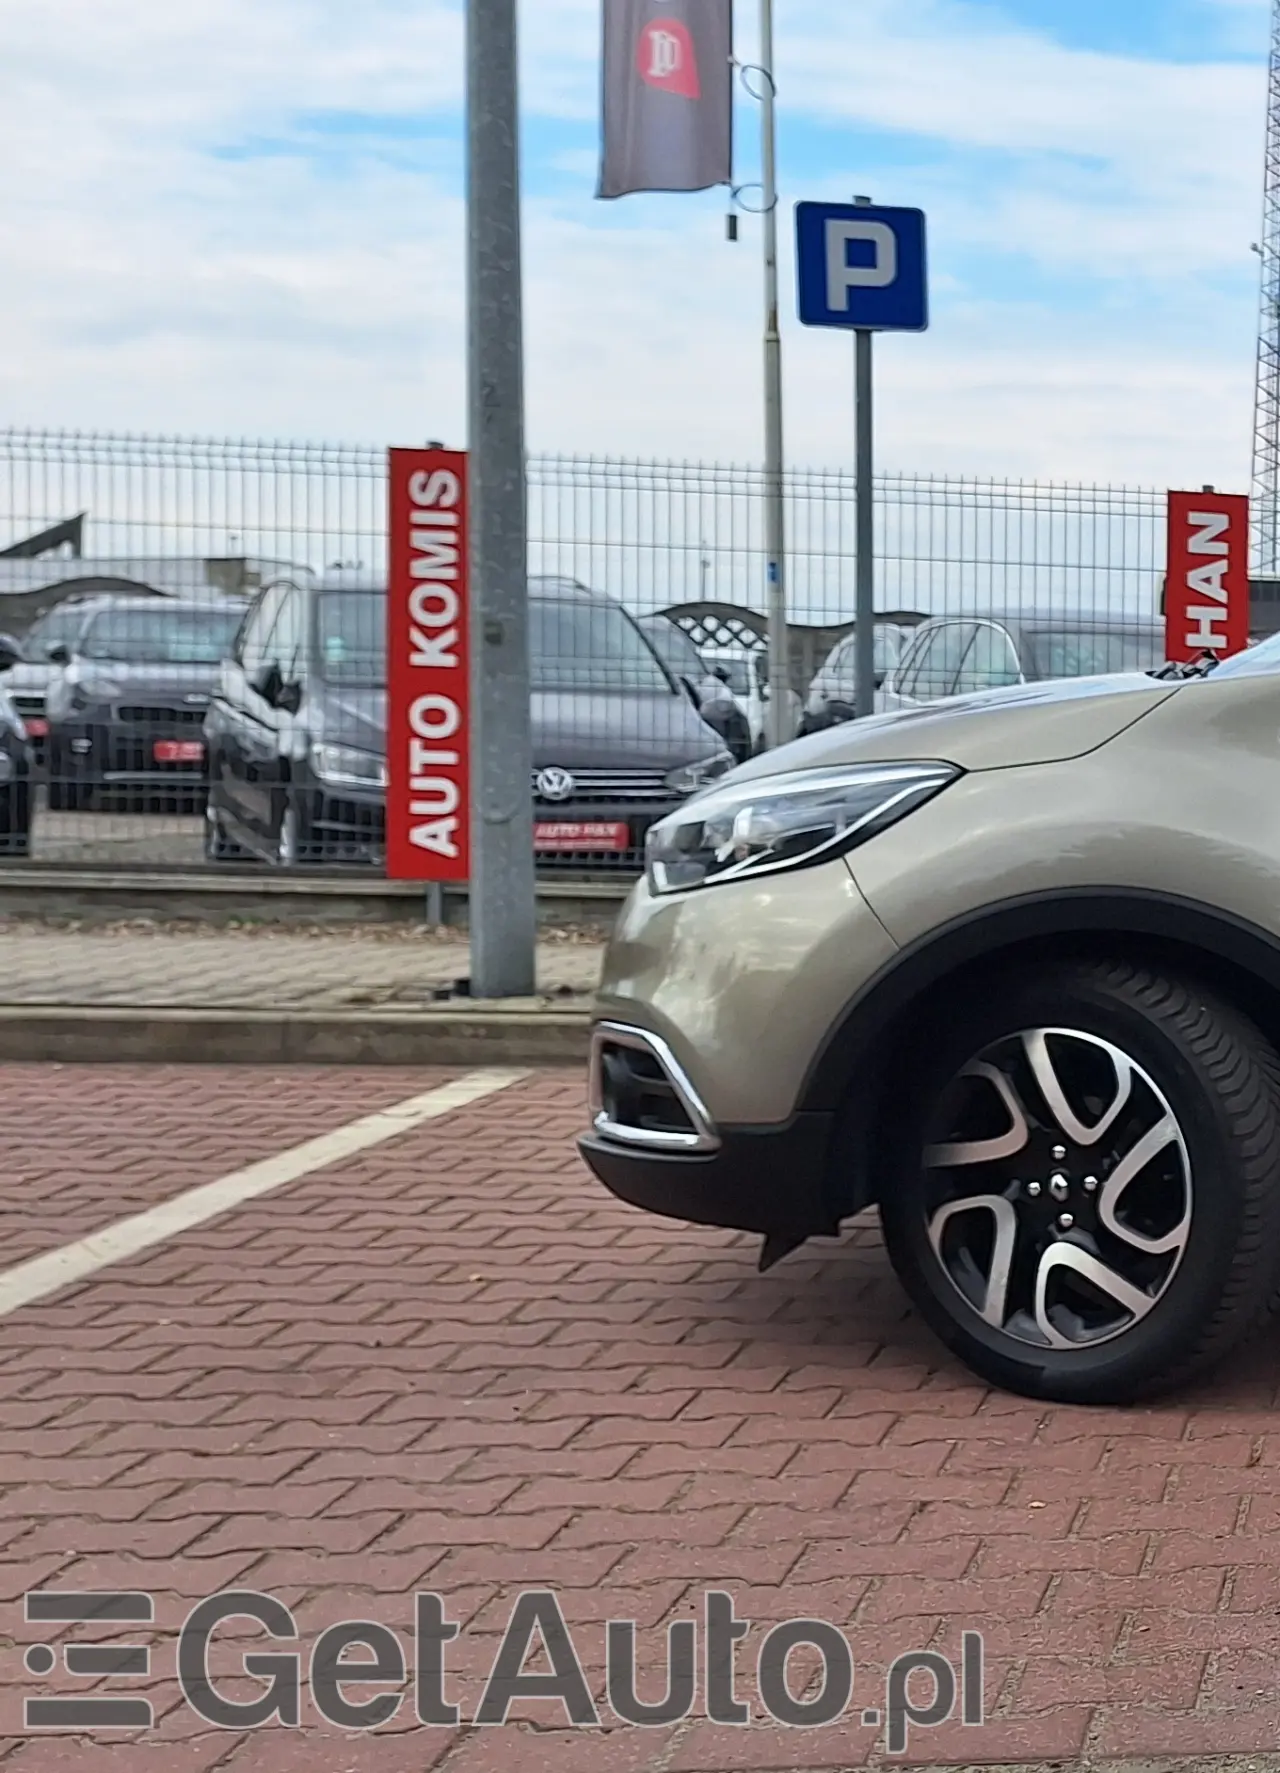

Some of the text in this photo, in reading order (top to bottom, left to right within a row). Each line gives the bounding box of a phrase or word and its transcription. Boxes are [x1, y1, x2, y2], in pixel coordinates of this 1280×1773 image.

[824, 217, 897, 311] P
[1185, 511, 1230, 648] HAN
[408, 469, 460, 858] AUTO KOMIS
